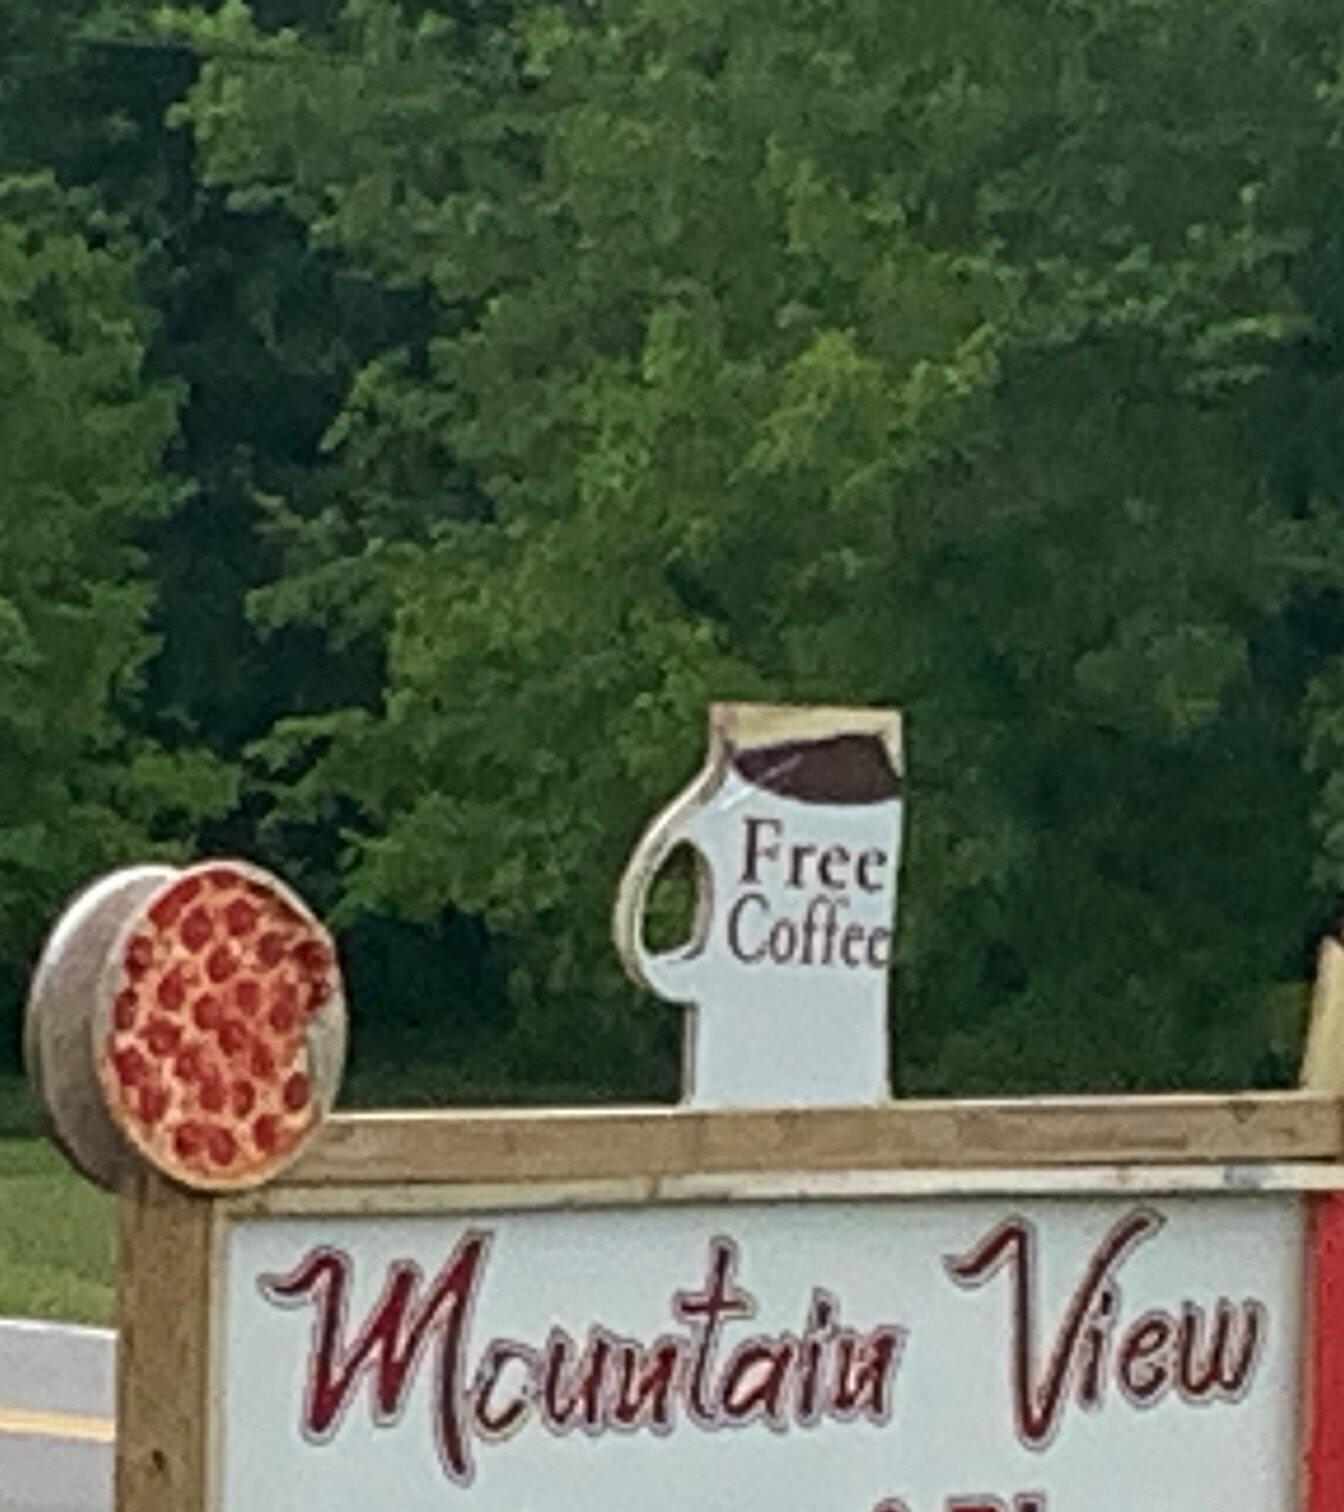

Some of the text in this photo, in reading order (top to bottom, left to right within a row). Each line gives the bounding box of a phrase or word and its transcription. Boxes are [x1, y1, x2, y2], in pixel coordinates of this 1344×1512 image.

[737, 814, 889, 893] Free
[726, 892, 893, 968] Coffee
[257, 1207, 1267, 1488] Mountain View
